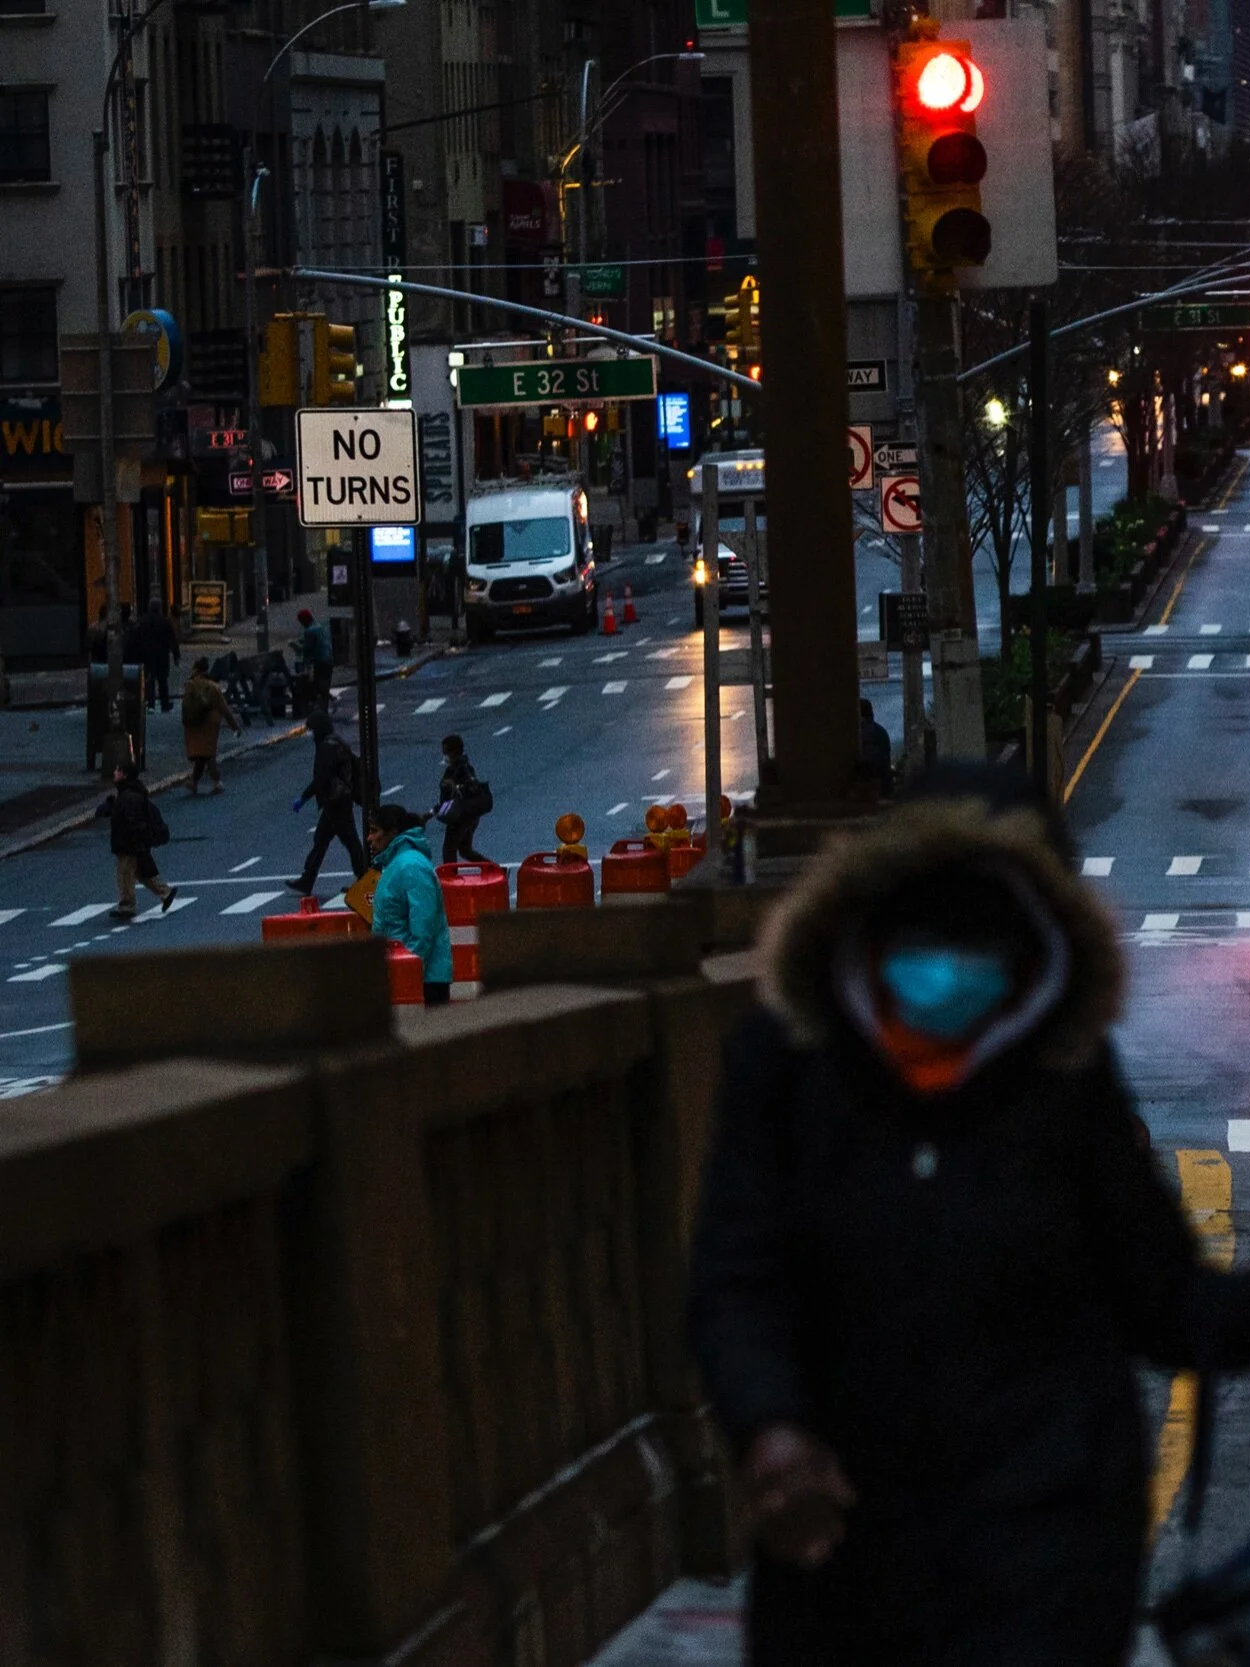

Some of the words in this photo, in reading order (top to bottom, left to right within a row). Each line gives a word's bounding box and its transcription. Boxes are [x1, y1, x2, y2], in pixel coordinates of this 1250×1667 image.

[385, 156, 399, 244] FIRST
[513, 372, 527, 396] E
[537, 369, 565, 395] 32
[576, 368, 600, 392] St
[333, 429, 381, 460] NO
[424, 412, 453, 503] SPREADS
[878, 451, 903, 462] ONE
[307, 475, 411, 505] TURNS
